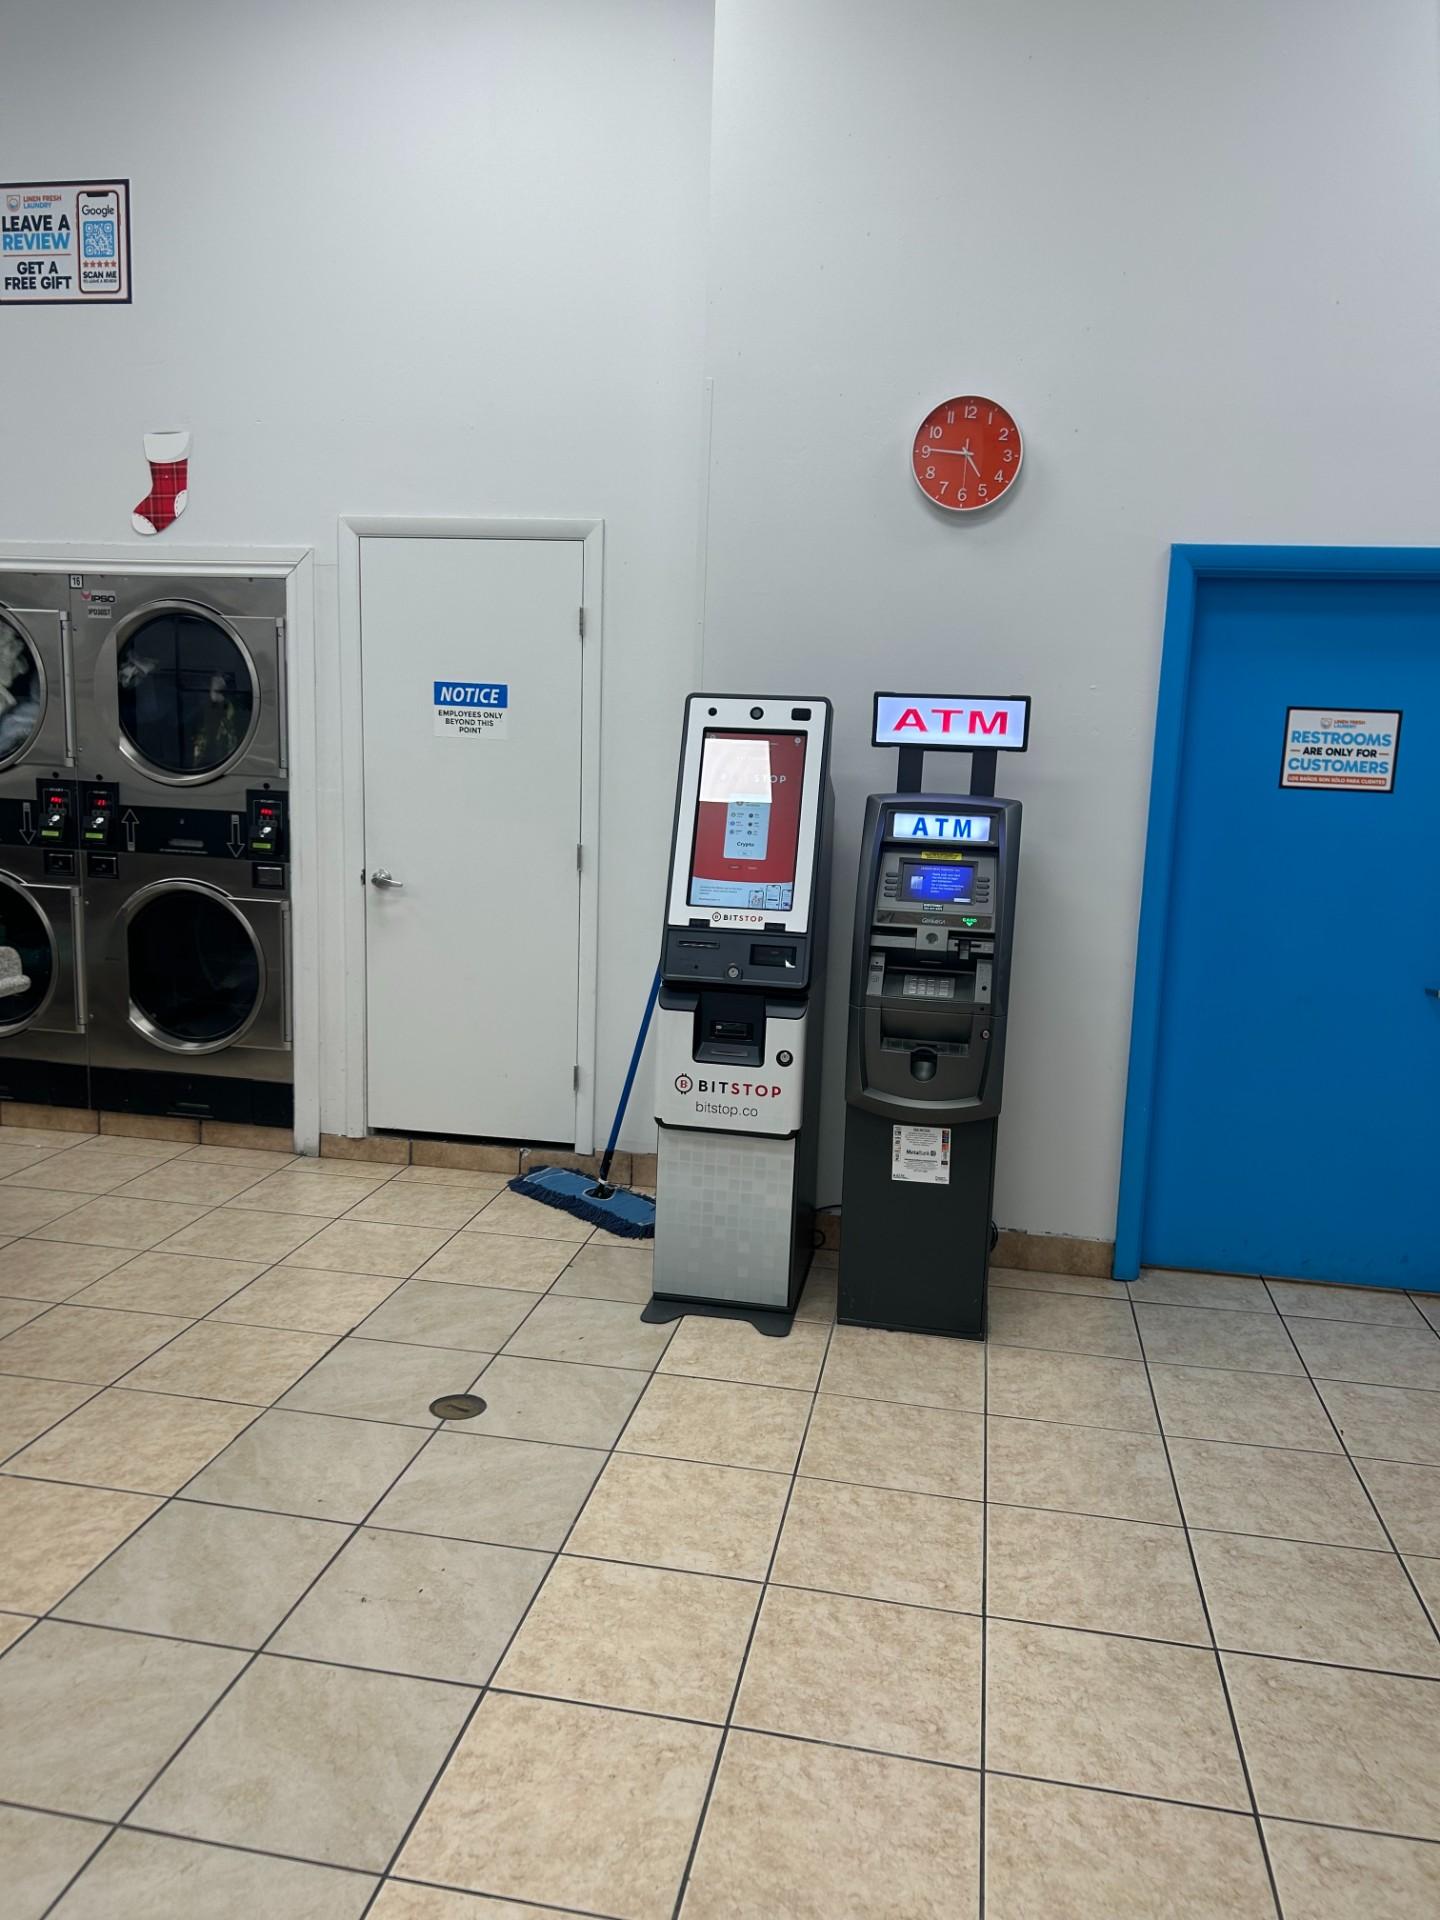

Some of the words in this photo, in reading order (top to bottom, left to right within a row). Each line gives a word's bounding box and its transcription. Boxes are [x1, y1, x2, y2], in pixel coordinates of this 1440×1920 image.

[81, 204, 115, 218] Google
[2, 214, 53, 232] LEAVE
[58, 214, 70, 231] A
[2, 232, 70, 250] REVIEW
[17, 261, 44, 274] GET
[48, 261, 58, 274] A
[83, 271, 104, 279] SCAN
[4, 277, 36, 290] FREE
[41, 276, 72, 289] GIFT
[947, 411, 955, 424] 11
[964, 406, 977, 419] 12
[988, 411, 992, 425] 1
[929, 426, 942, 439] 10
[998, 428, 1009, 441] 2
[922, 445, 931, 458] 9
[1003, 449, 1012, 462] 3
[926, 466, 936, 479] 8
[994, 470, 1004, 483] 4
[939, 481, 949, 494] 7
[978, 484, 988, 496] 5
[958, 488, 967, 501] 6
[91, 595, 116, 603] IPSO
[440, 686, 500, 704] NOTICE
[438, 710, 481, 718] EMPLOYEES
[892, 708, 1008, 736] ATM
[1291, 731, 1392, 746] RESTROOMS
[1303, 747, 1322, 755] ARE
[1326, 748, 1353, 757] ONLY
[1356, 749, 1377, 758] FOR
[1288, 758, 1389, 774] CUSTOMERS
[912, 817, 972, 838] ATM
[723, 914, 764, 922] BITSTOP
[699, 1080, 782, 1098] BITSTOP
[696, 1101, 758, 1117] bitstop.co
